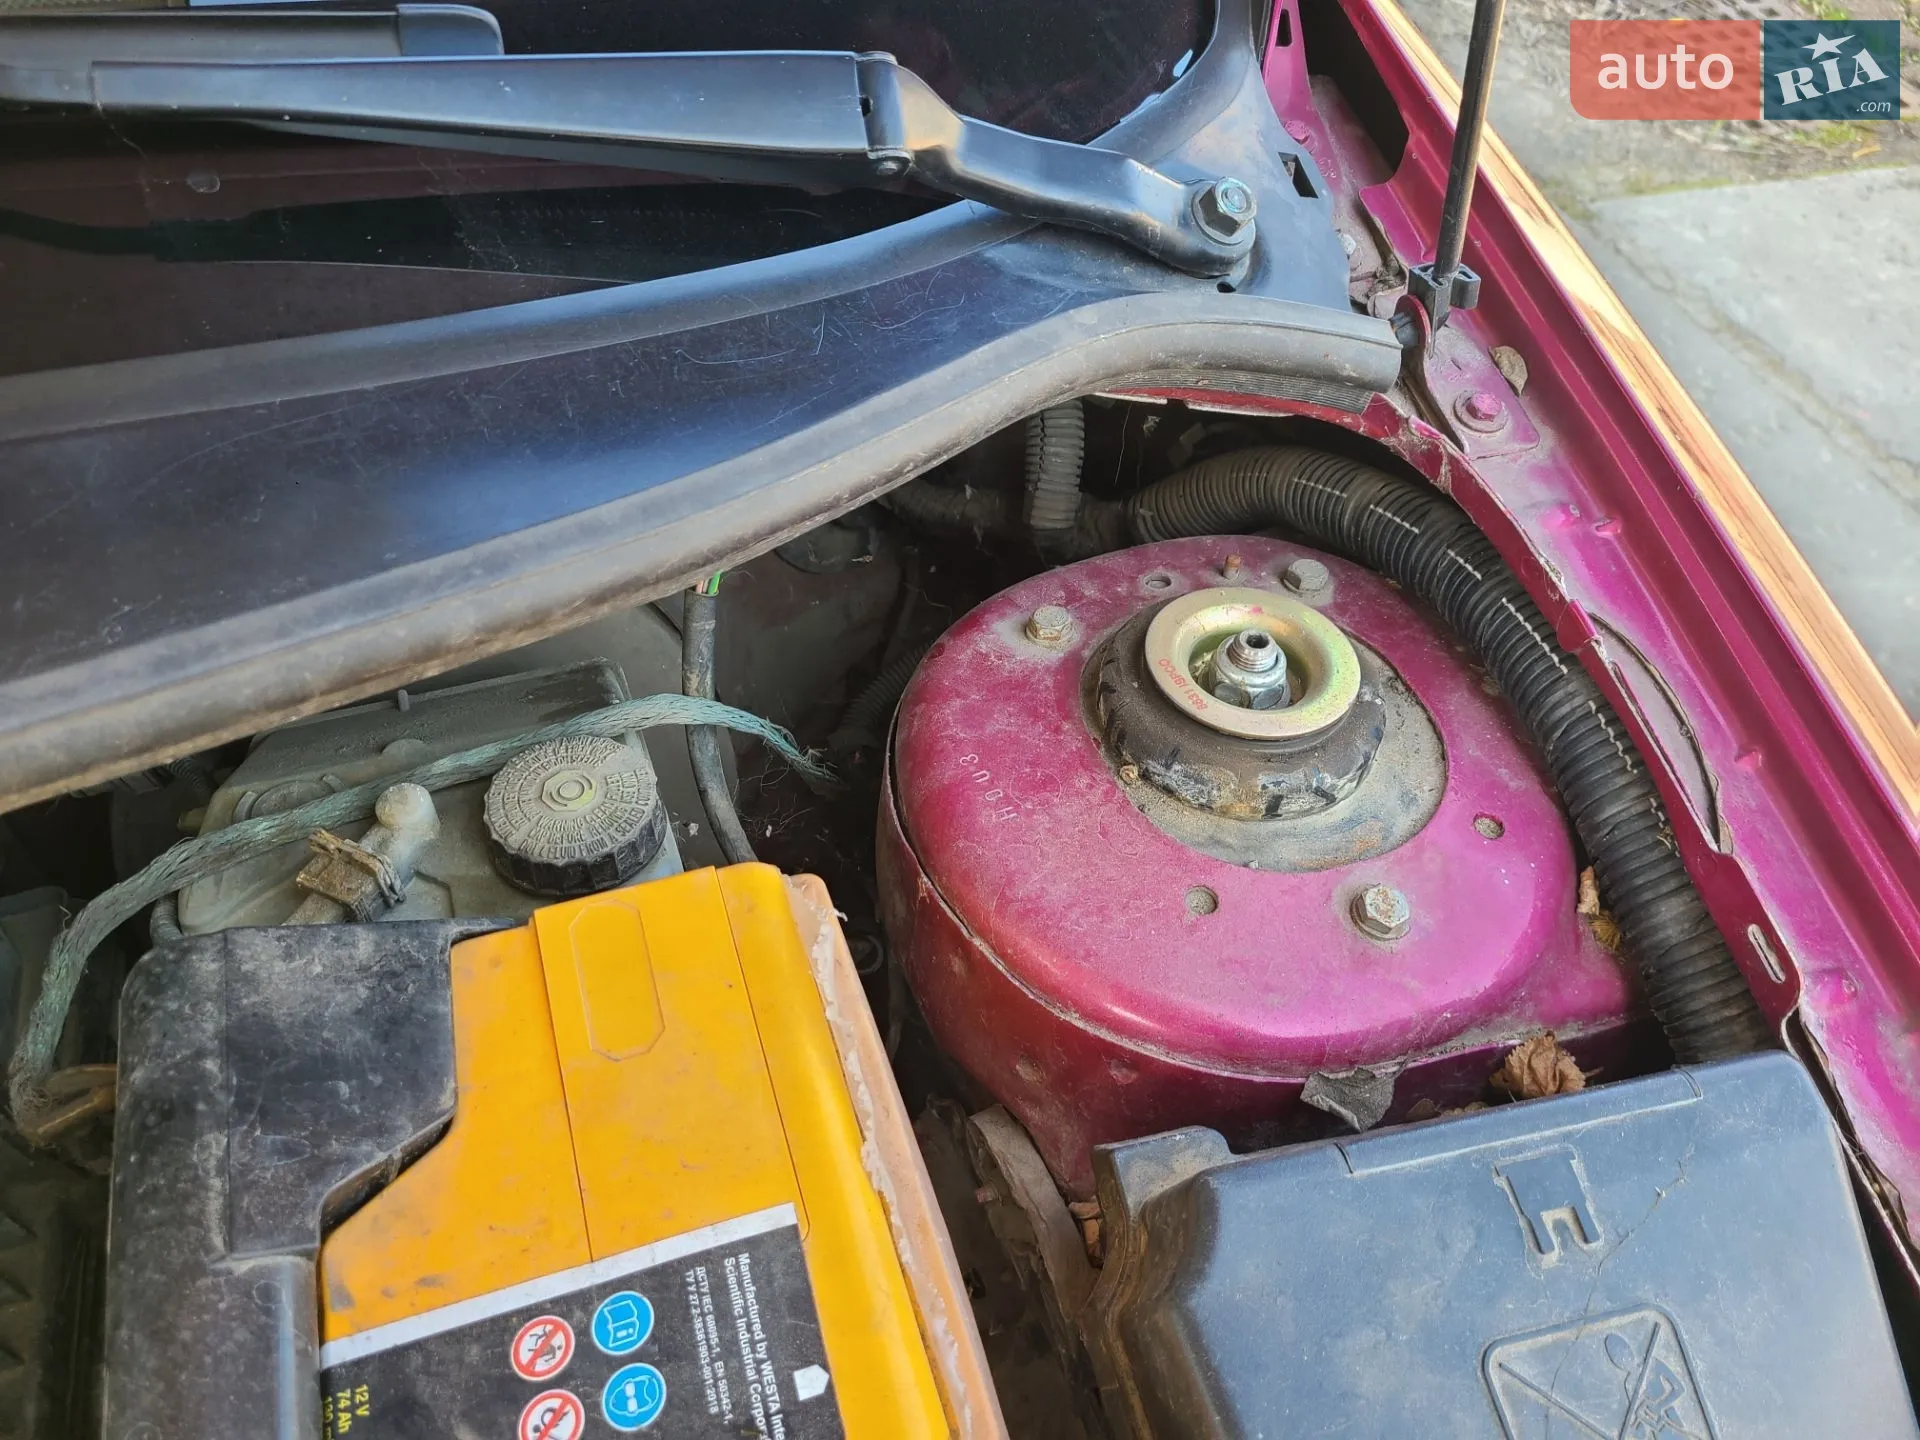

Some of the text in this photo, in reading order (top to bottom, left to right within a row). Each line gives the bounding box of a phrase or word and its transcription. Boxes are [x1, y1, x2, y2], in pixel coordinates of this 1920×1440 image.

[537, 815, 585, 832] WARNING
[584, 801, 616, 826] CLEAN
[578, 836, 609, 857] FROM
[615, 806, 646, 838] SEALED
[724, 1256, 744, 1317] Scientific
[735, 1316, 760, 1381] Industrial
[738, 1252, 767, 1341] Manufactured
[714, 1360, 726, 1378] EN
[755, 1340, 768, 1360] by
[354, 1383, 370, 1416] 12 V
[760, 1360, 781, 1415] WESTA
[336, 1388, 353, 1434] 74 Ah
